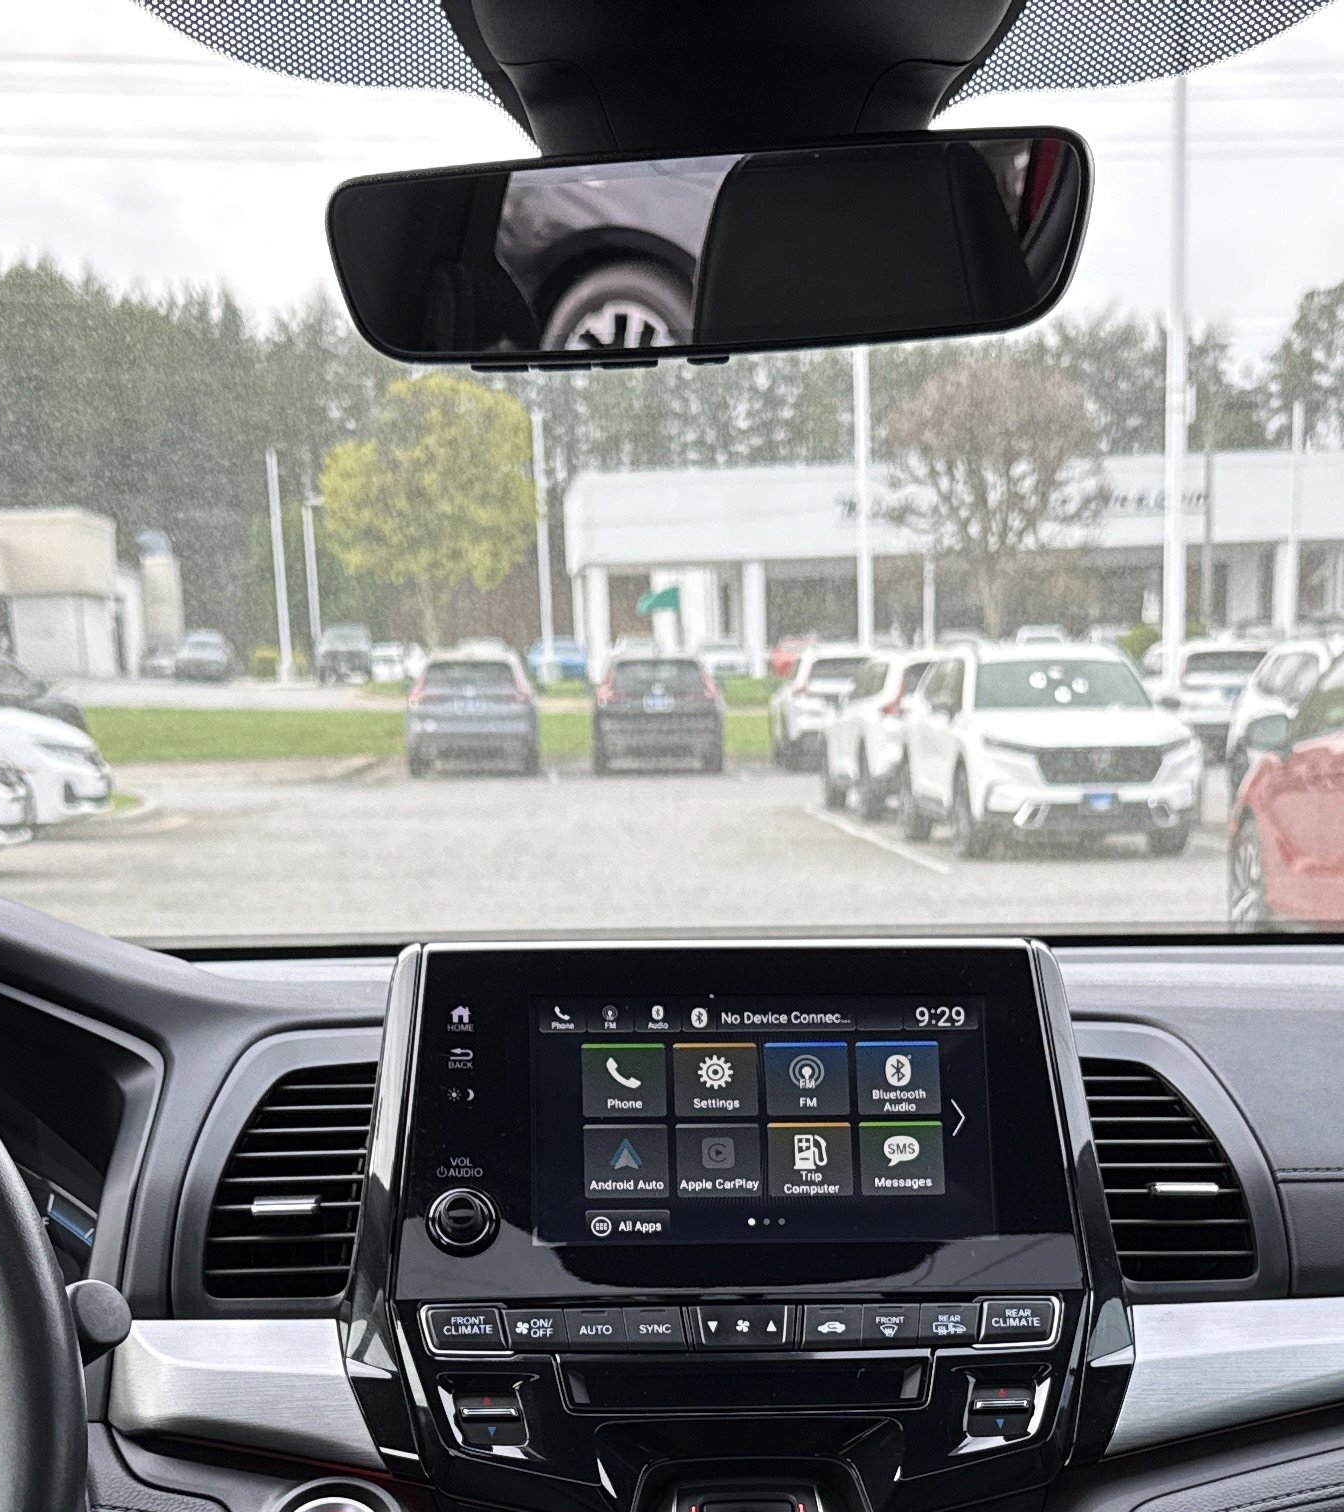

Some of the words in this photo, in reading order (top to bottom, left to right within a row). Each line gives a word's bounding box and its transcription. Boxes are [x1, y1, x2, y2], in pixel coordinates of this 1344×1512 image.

[721, 1012, 740, 1025] No
[743, 1011, 788, 1025] Device
[915, 1006, 965, 1027] 9:29
[447, 1024, 474, 1032] HOME
[550, 1022, 575, 1030] Phone
[605, 1021, 616, 1030] FM
[647, 1021, 669, 1030] Audio
[448, 1061, 473, 1069] BACK
[872, 1089, 926, 1100] Bluetooth
[607, 1098, 643, 1109] Phone
[693, 1098, 740, 1111] Settings
[799, 1097, 817, 1108] FM
[883, 1101, 916, 1112] Audio
[887, 1143, 916, 1155] SMS
[450, 1157, 473, 1167] VOL
[448, 1167, 483, 1178] AUDIO
[800, 1171, 822, 1183] Trip
[589, 1179, 634, 1190] Android
[637, 1179, 664, 1190] Auto
[679, 1179, 713, 1192] Apple
[715, 1178, 759, 1192] CarPlay
[874, 1177, 933, 1190] Messages
[783, 1183, 839, 1196] Computer
[618, 1221, 633, 1232] All
[635, 1221, 662, 1233] Apps
[938, 1314, 961, 1322] REAR
[1005, 1308, 1031, 1318] REAR
[451, 1316, 485, 1325] FRONT
[530, 1318, 553, 1329] ON/
[875, 1316, 904, 1324] FRONT
[991, 1316, 1041, 1328] CLIMATE
[443, 1324, 493, 1335] CLIMATE
[530, 1327, 553, 1338] OFF
[579, 1325, 613, 1335] AUTO
[639, 1323, 672, 1334] SYNC
